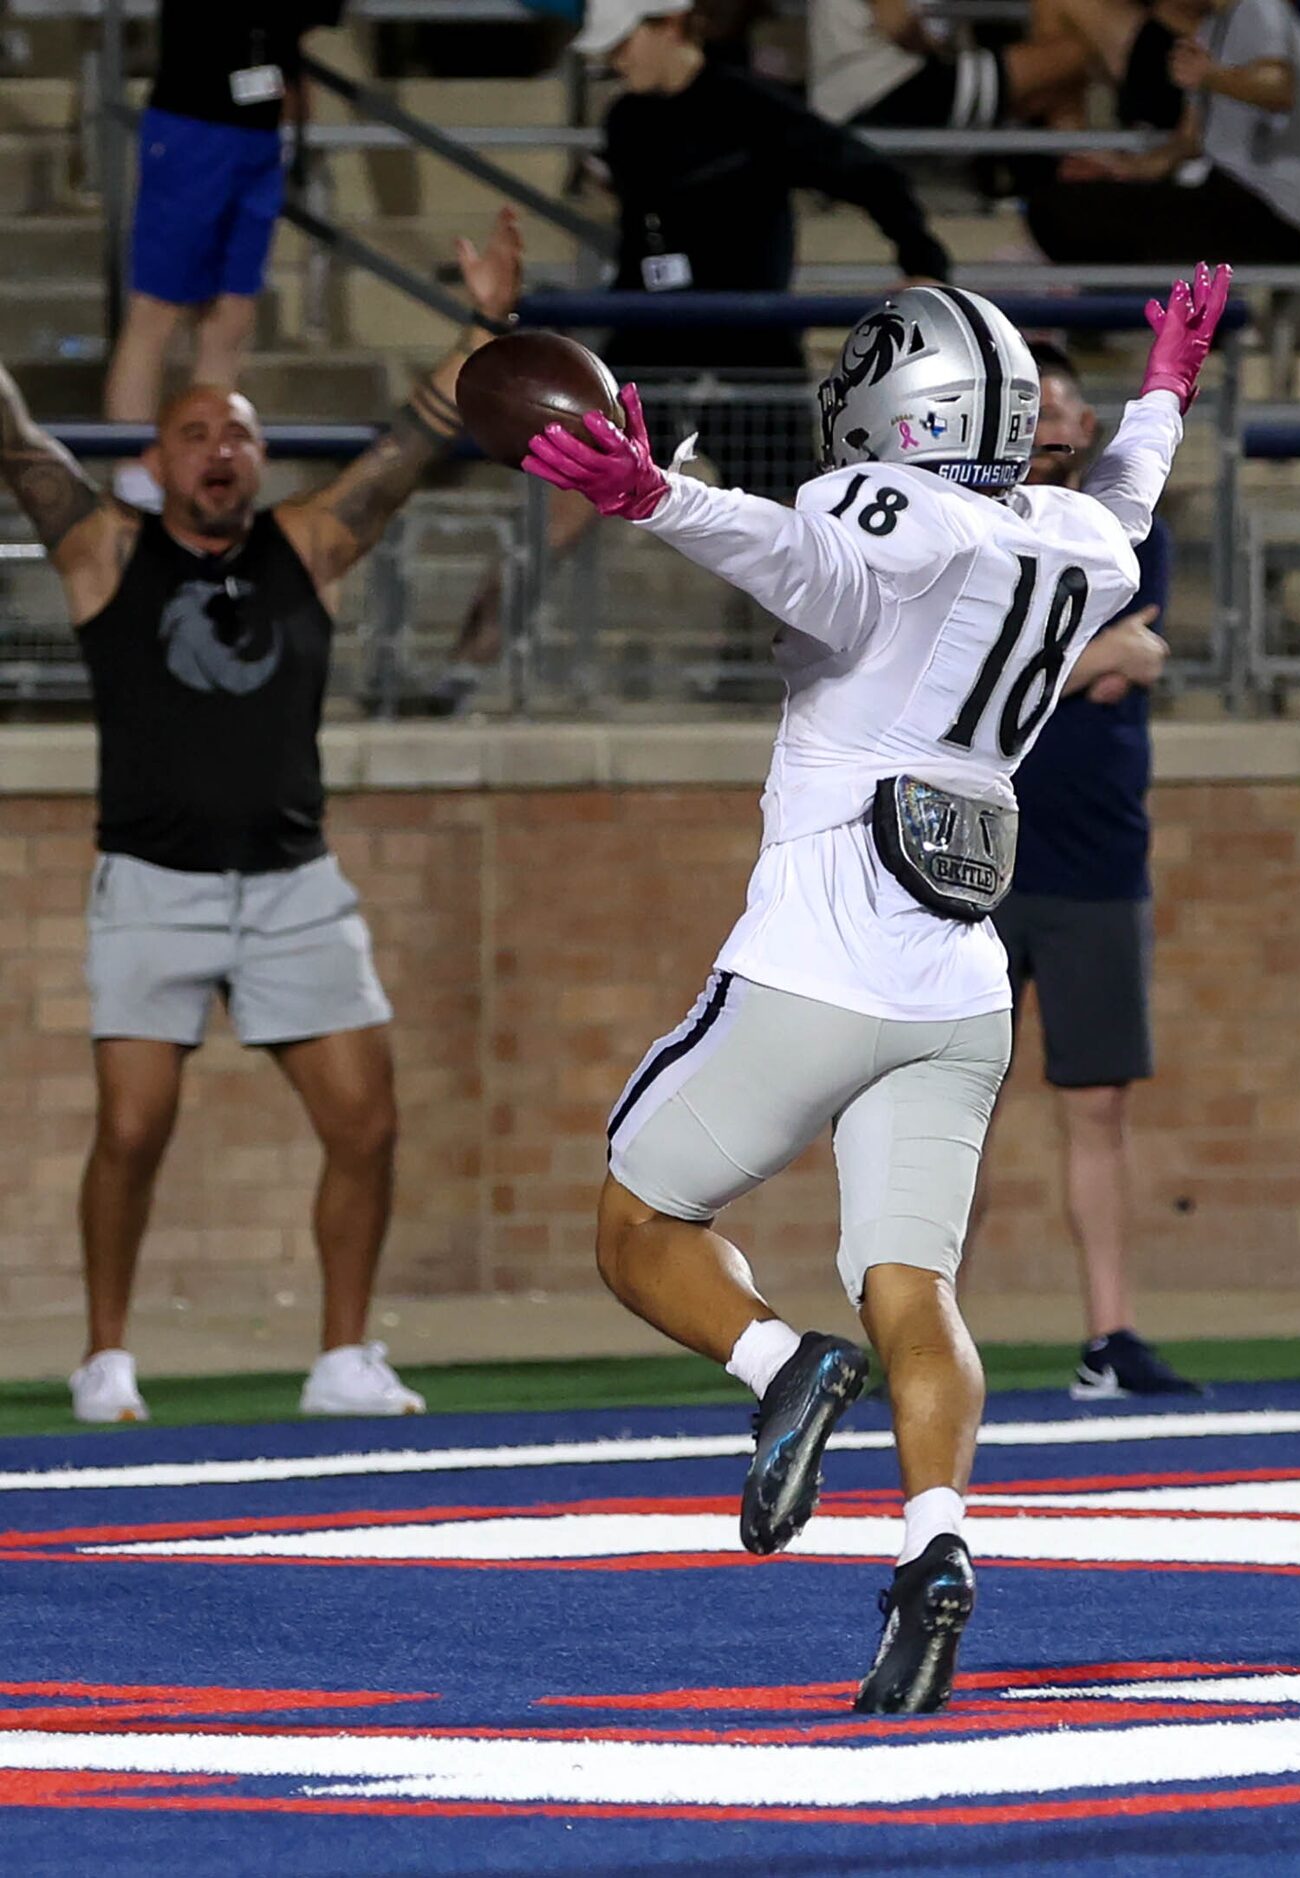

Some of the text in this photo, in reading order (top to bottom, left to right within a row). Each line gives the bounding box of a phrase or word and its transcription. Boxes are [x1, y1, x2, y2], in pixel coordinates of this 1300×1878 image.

[829, 473, 908, 536] 18
[938, 463, 1018, 484] SOUTHSIDE
[937, 550, 1089, 758] 18
